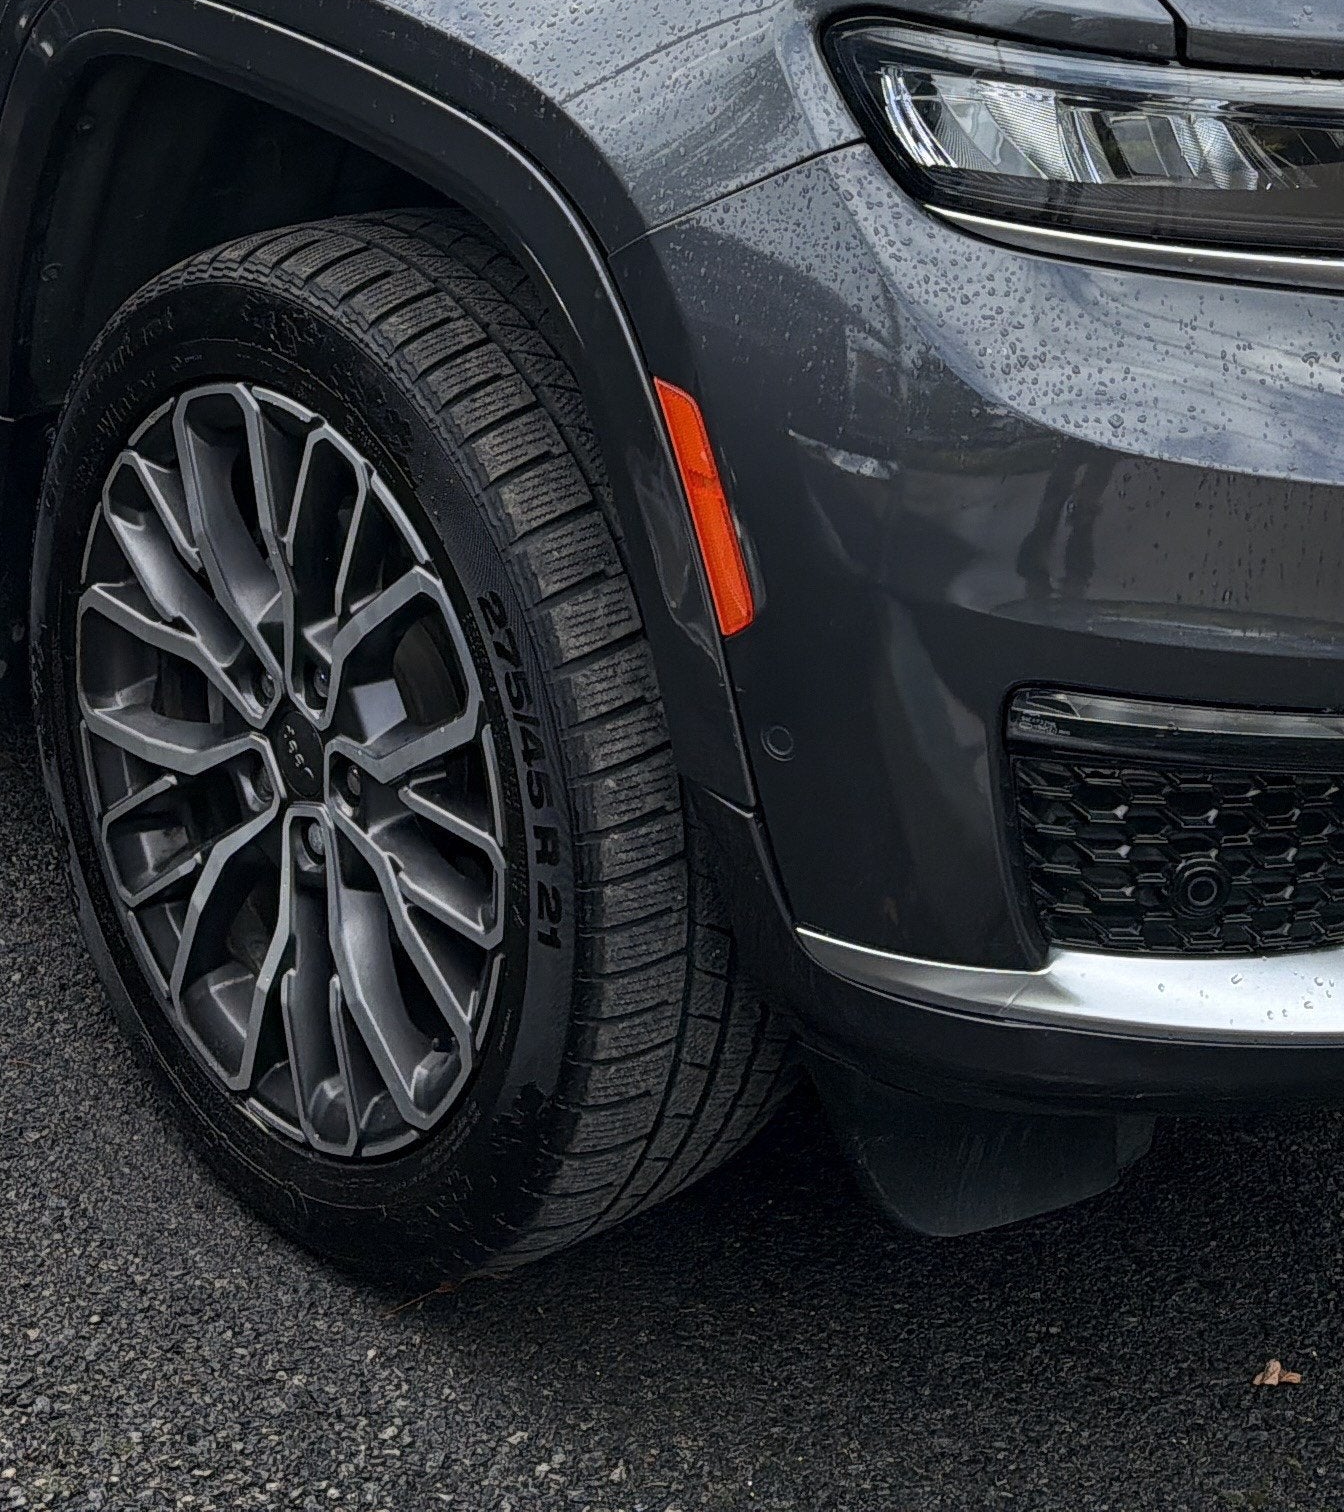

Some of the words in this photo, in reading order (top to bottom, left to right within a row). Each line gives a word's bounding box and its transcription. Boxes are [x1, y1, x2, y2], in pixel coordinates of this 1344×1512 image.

[476, 590, 552, 810] 275/45
[533, 824, 561, 867] R
[537, 879, 563, 950] 21
